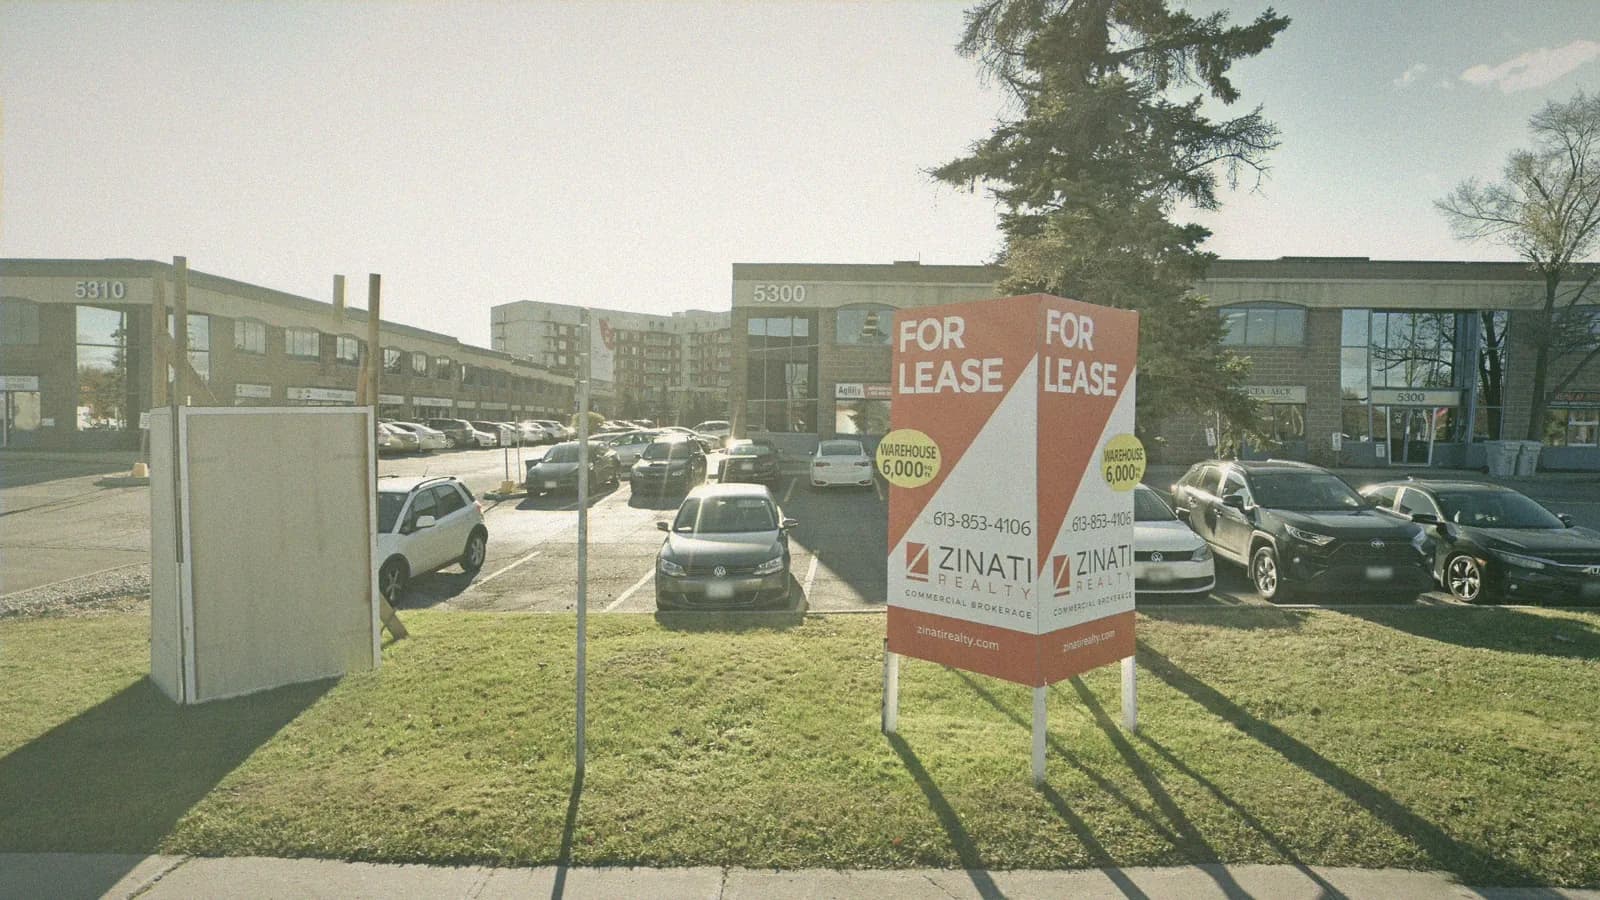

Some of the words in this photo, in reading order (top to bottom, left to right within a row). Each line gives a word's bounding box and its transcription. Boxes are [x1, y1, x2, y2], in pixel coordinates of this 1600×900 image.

[75, 281, 126, 299] 5310
[753, 284, 806, 302] 5300
[900, 316, 965, 352] FOR
[1046, 309, 1094, 351] FOR
[899, 358, 1003, 394] LEASE
[1044, 356, 1117, 397] LEASE
[838, 385, 862, 396] Agility
[1397, 392, 1425, 402] 5300
[880, 443, 936, 460] WAREHOUSE
[1104, 447, 1143, 463] WAREHOUSE
[883, 459, 923, 479] 6,000
[1106, 463, 1135, 484] 6,000
[933, 511, 1032, 536] 613-853-4106
[1072, 511, 1131, 532] 613-853-4106
[938, 546, 1032, 583] ZINATI
[1076, 544, 1131, 576] ZINATI
[938, 574, 1032, 600] REALTY
[1076, 571, 1132, 591] REALTY
[905, 589, 967, 607] COMMERCIAL
[971, 601, 1032, 619] BROKERAGE
[1053, 601, 1096, 617] COMMERCIAL
[1098, 591, 1132, 606] BROKERAGE
[917, 625, 1000, 651] zinatirealty.com
[1063, 630, 1115, 652] zinatirealty.com
